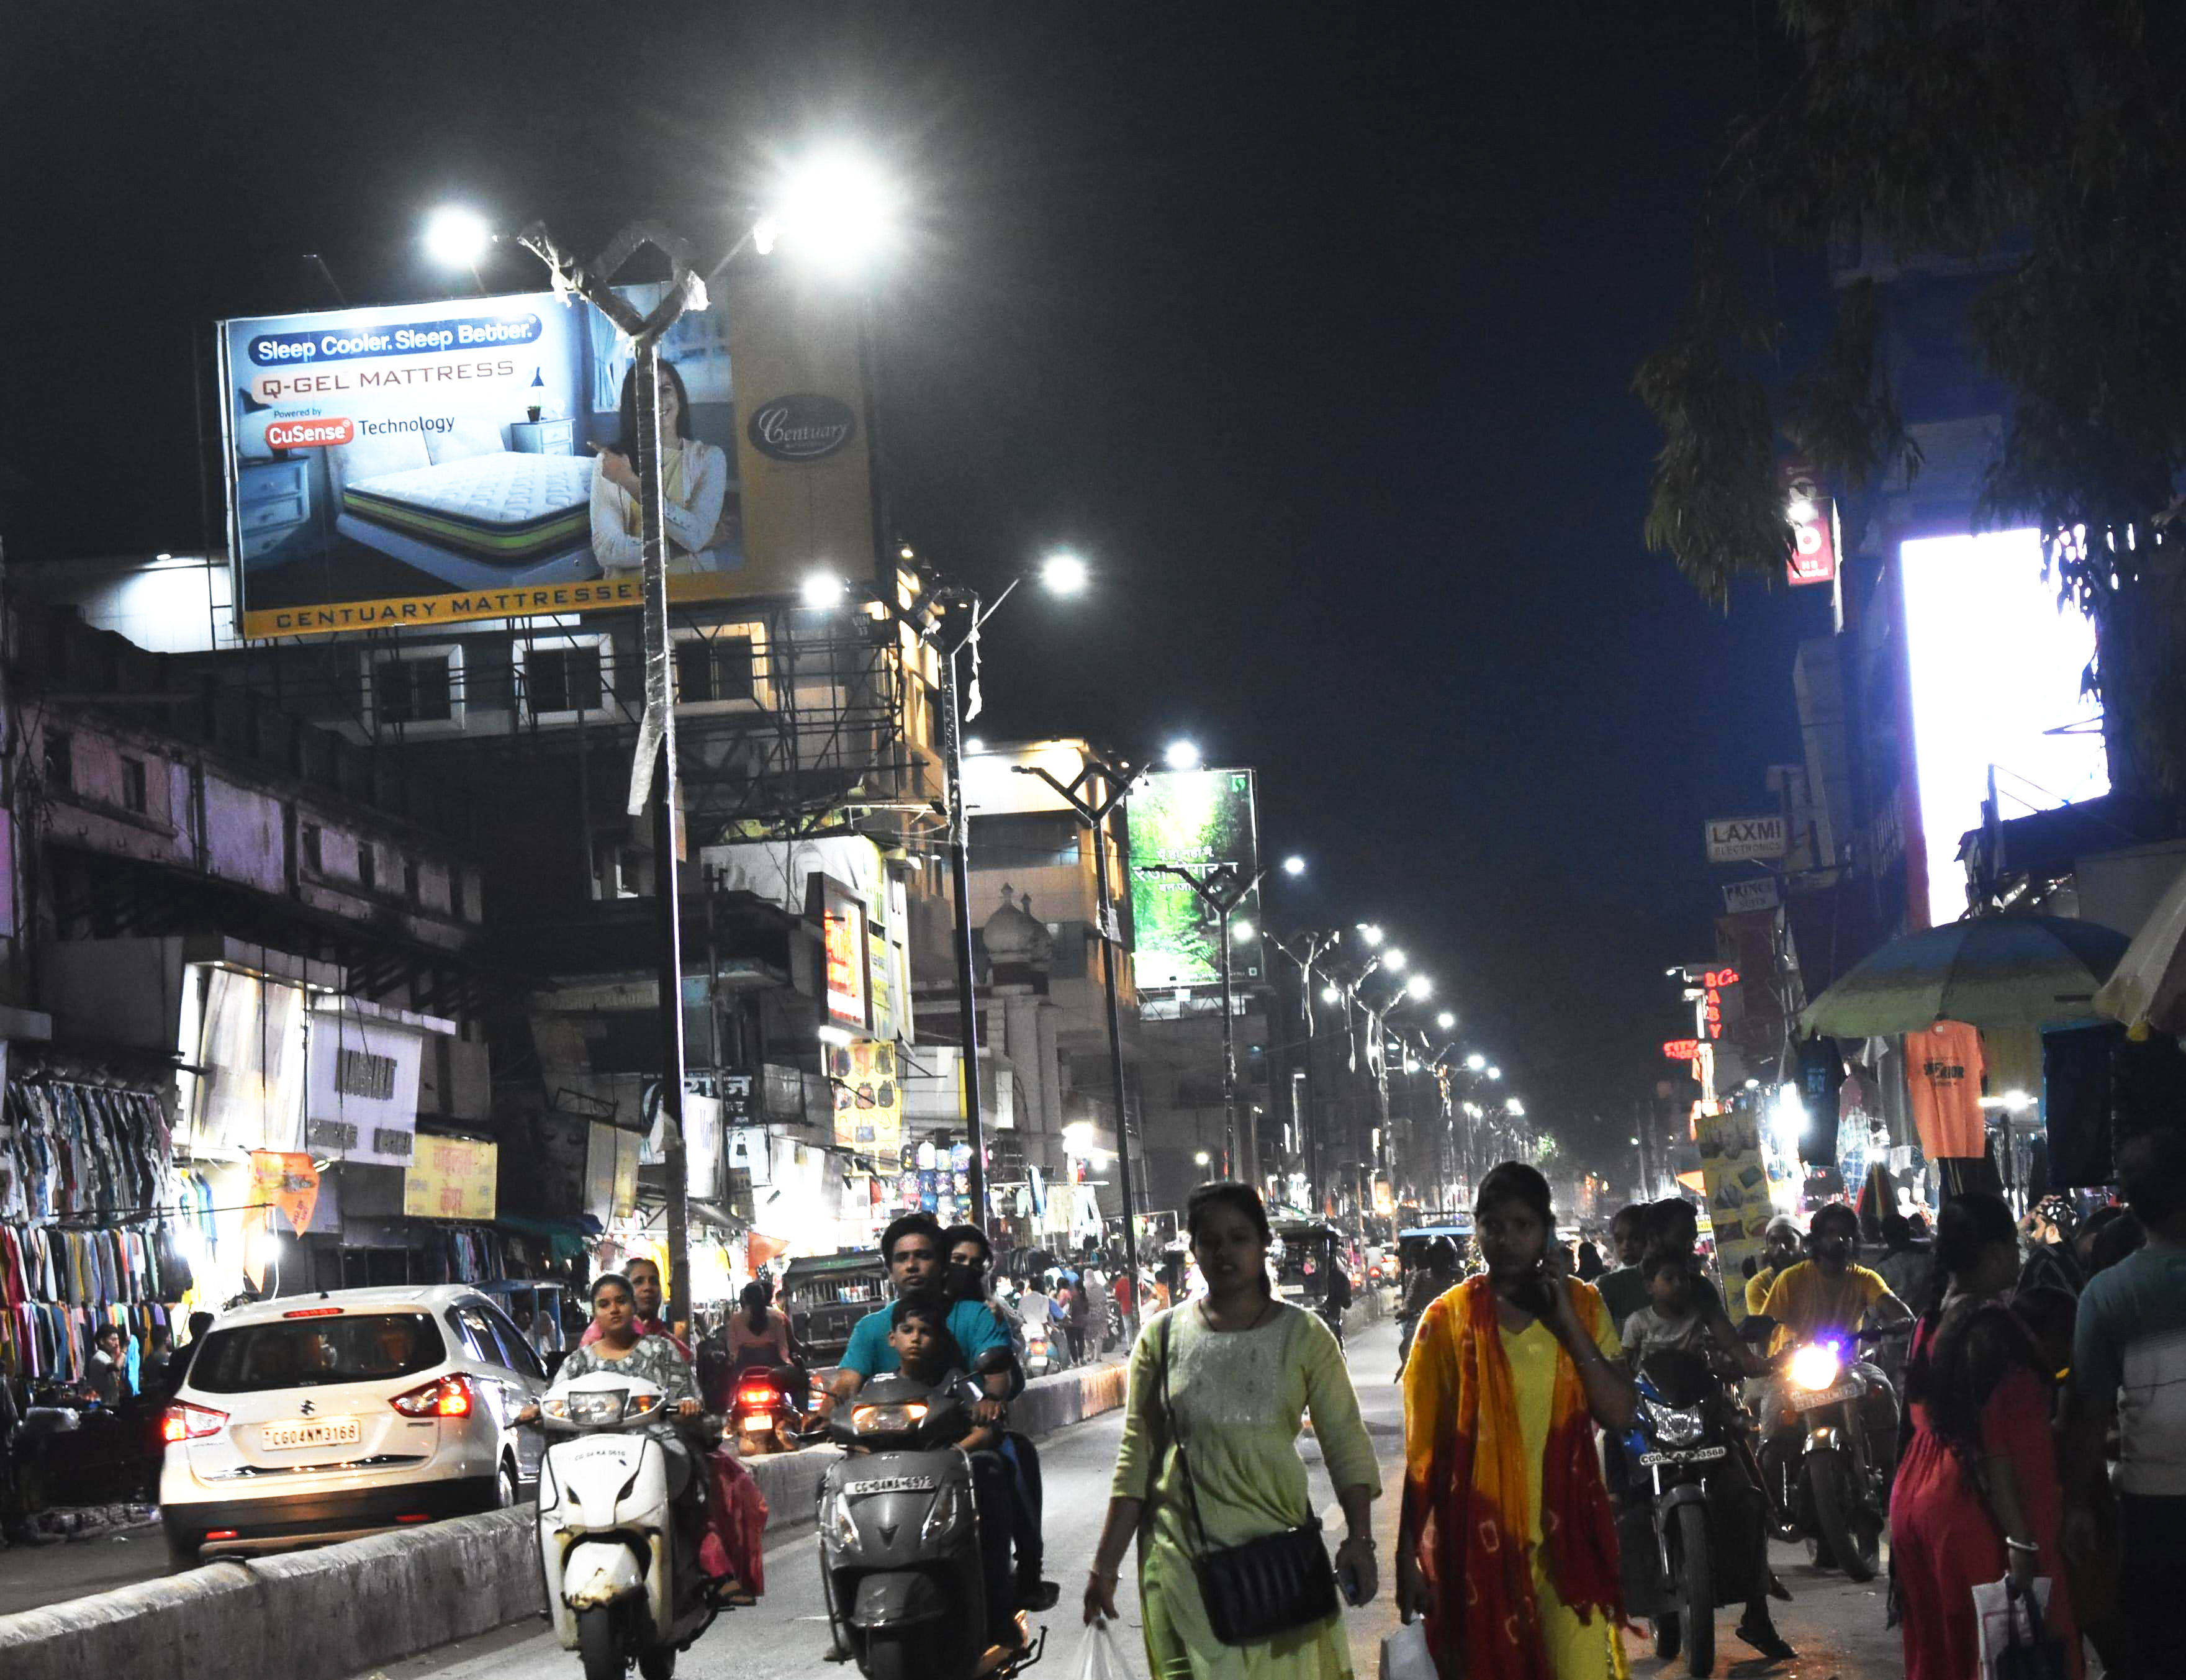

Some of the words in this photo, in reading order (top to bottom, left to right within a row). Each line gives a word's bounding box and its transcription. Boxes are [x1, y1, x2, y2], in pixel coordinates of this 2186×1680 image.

[259, 341, 316, 363] Sleep
[321, 332, 392, 355] Cooler.
[395, 327, 453, 350] Sleep
[458, 322, 532, 344] Better.
[263, 375, 350, 399] Q-GEL
[360, 361, 513, 387] MATTRESS
[274, 408, 310, 418] Powered
[312, 407, 322, 417] by
[269, 425, 345, 445] CuSense
[359, 415, 454, 436] Technology
[276, 602, 437, 629] CENTUARY
[1713, 820, 1781, 843] LAXMI
